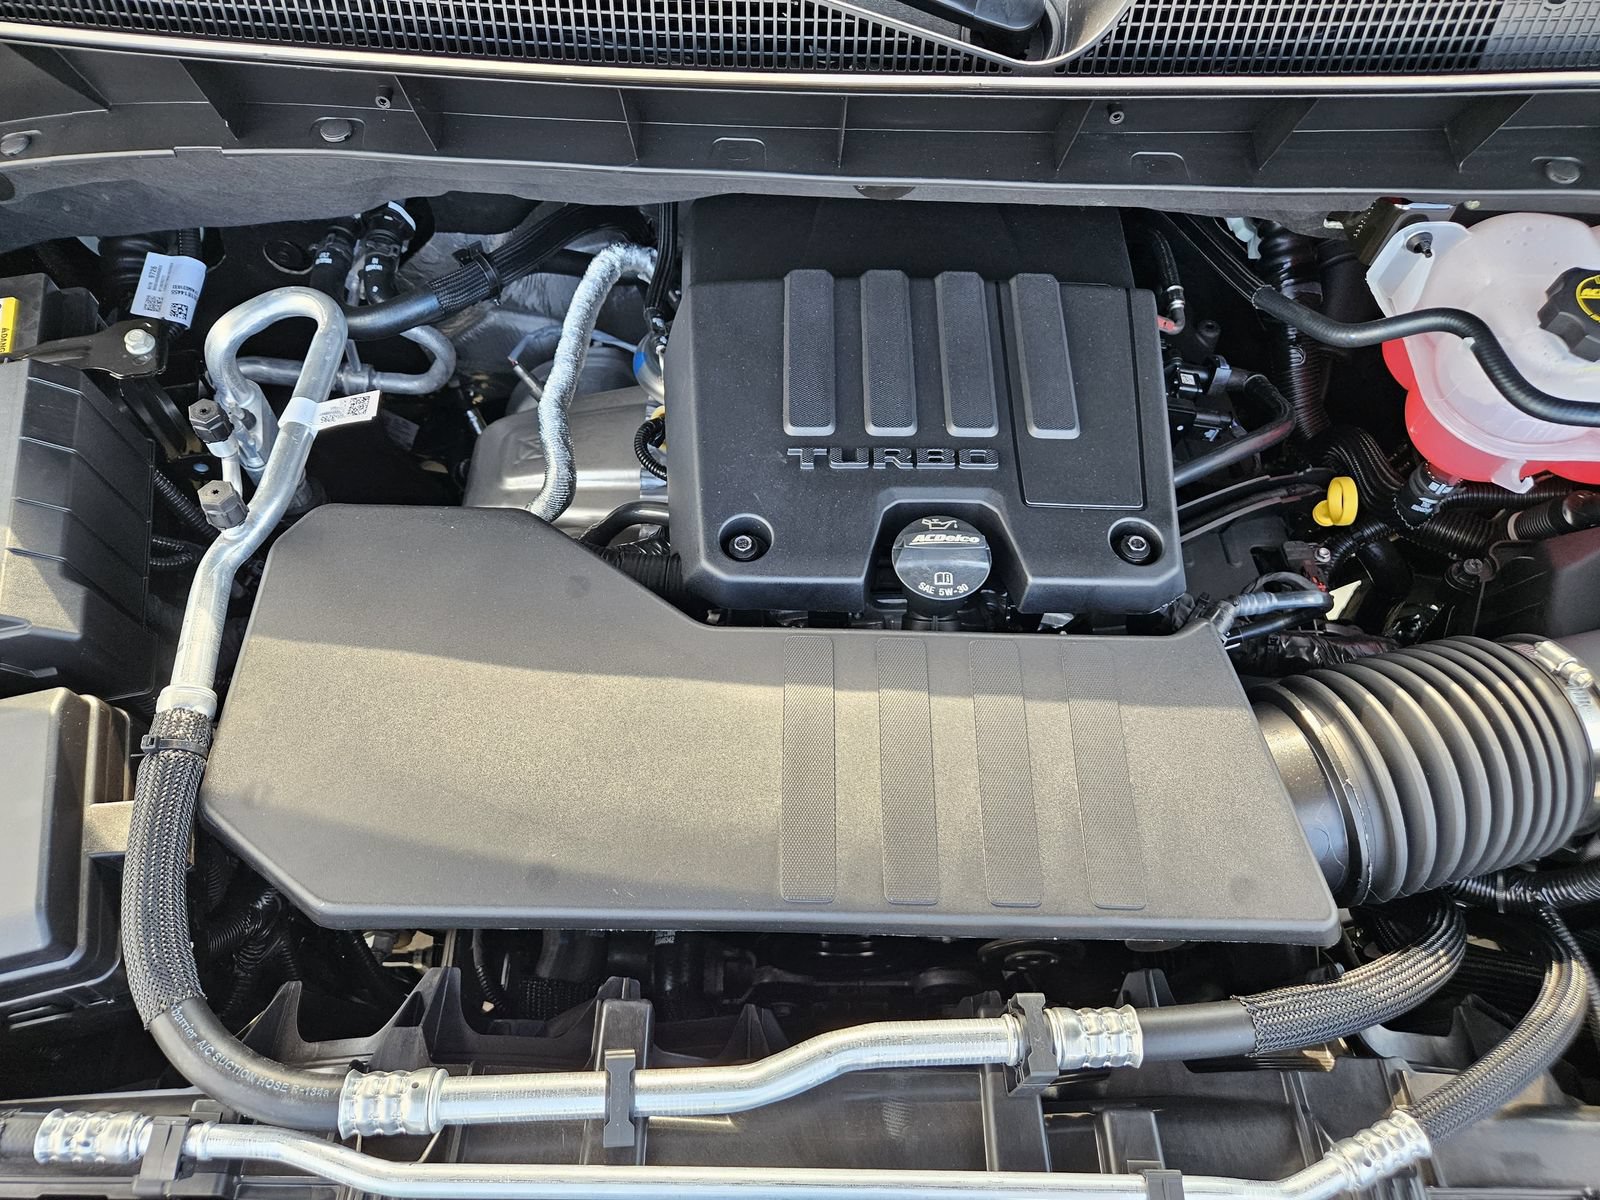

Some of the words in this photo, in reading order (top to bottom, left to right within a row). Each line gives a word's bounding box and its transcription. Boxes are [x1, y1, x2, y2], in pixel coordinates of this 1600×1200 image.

[787, 447, 999, 470] TURBO
[911, 534, 980, 544] ACDelco
[918, 582, 936, 595] SAE
[938, 583, 969, 596] 5W-30
[196, 1039, 214, 1057] A/C
[212, 1052, 258, 1085] SUCTION
[257, 1076, 289, 1093] HOSE
